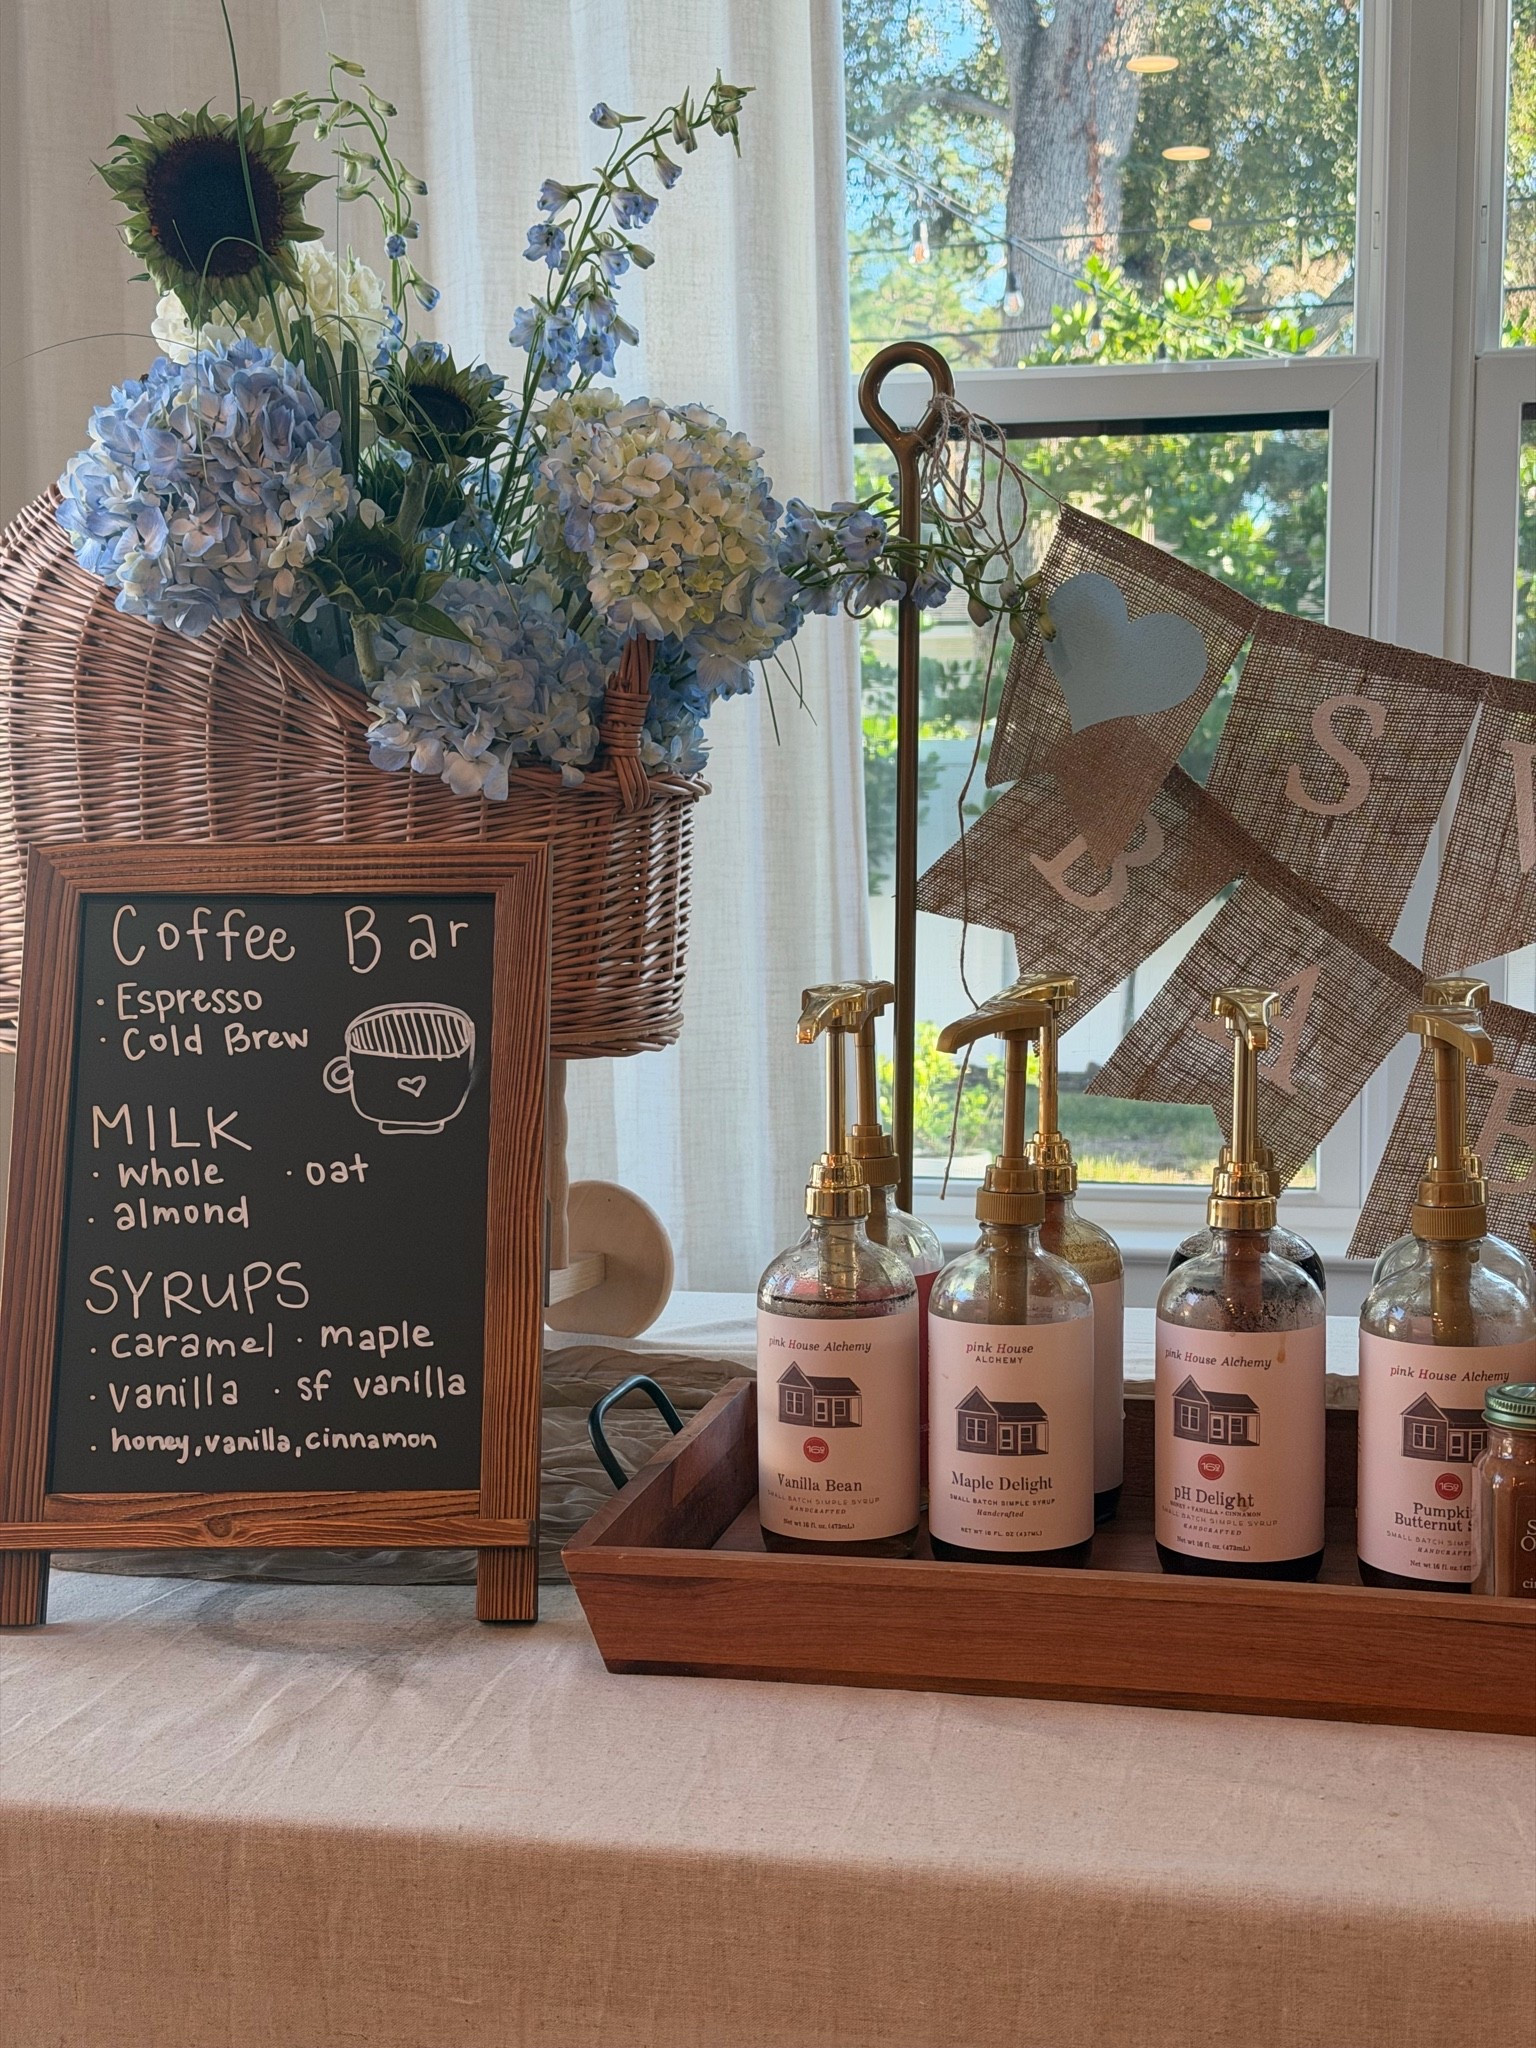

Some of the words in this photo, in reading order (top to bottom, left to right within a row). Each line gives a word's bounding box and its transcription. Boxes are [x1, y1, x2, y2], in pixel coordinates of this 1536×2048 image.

[112, 904, 297, 967] Coffee
[344, 904, 470, 975] Bar
[116, 982, 264, 1023] Espresso
[122, 1022, 204, 1062] Cold
[224, 1021, 309, 1057] Brew
[92, 1103, 253, 1152] MILK
[118, 1156, 225, 1189] whole
[305, 1152, 370, 1187] oat
[113, 1194, 250, 1232] almond
[85, 1260, 310, 1319] SYRUPS
[111, 1322, 274, 1360] caramel
[320, 1320, 435, 1359] maple
[769, 1336, 786, 1348] pink
[788, 1339, 820, 1352] House
[823, 1340, 872, 1354] Alchemy
[965, 1341, 993, 1354] pink
[996, 1343, 1034, 1354] House
[975, 1355, 1024, 1364] ALCHEMY
[1165, 1348, 1182, 1360] pink
[1184, 1351, 1217, 1366] House
[1221, 1356, 1272, 1371] Alchemy
[1390, 1365, 1416, 1378] pink
[1418, 1368, 1457, 1382] House
[1461, 1370, 1510, 1383] Alchemy
[108, 1372, 239, 1414] vanilla
[297, 1368, 332, 1402] sf
[353, 1364, 468, 1400] vanilla
[777, 1473, 820, 1492] Vanilla
[825, 1479, 862, 1492] Bean
[951, 1470, 994, 1493] Maple
[999, 1475, 1054, 1495] Delight
[949, 1493, 970, 1503] SMALL
[972, 1498, 998, 1506] BATCH
[1032, 1498, 1056, 1507] SYRUP
[1174, 1486, 1192, 1501] pH
[1195, 1488, 1255, 1510] Delight
[976, 1508, 1025, 1519] Handcrafted
[1181, 1513, 1207, 1523] BATCH
[1209, 1518, 1244, 1527] SIMPLE
[1247, 1520, 1279, 1528] SYRUP
[1225, 1510, 1262, 1518] CINNAMON
[1394, 1511, 1463, 1533] Butternut
[1413, 1502, 1473, 1520] Pumpki
[1386, 1530, 1413, 1542] SMALL
[1415, 1537, 1445, 1546] BATCH
